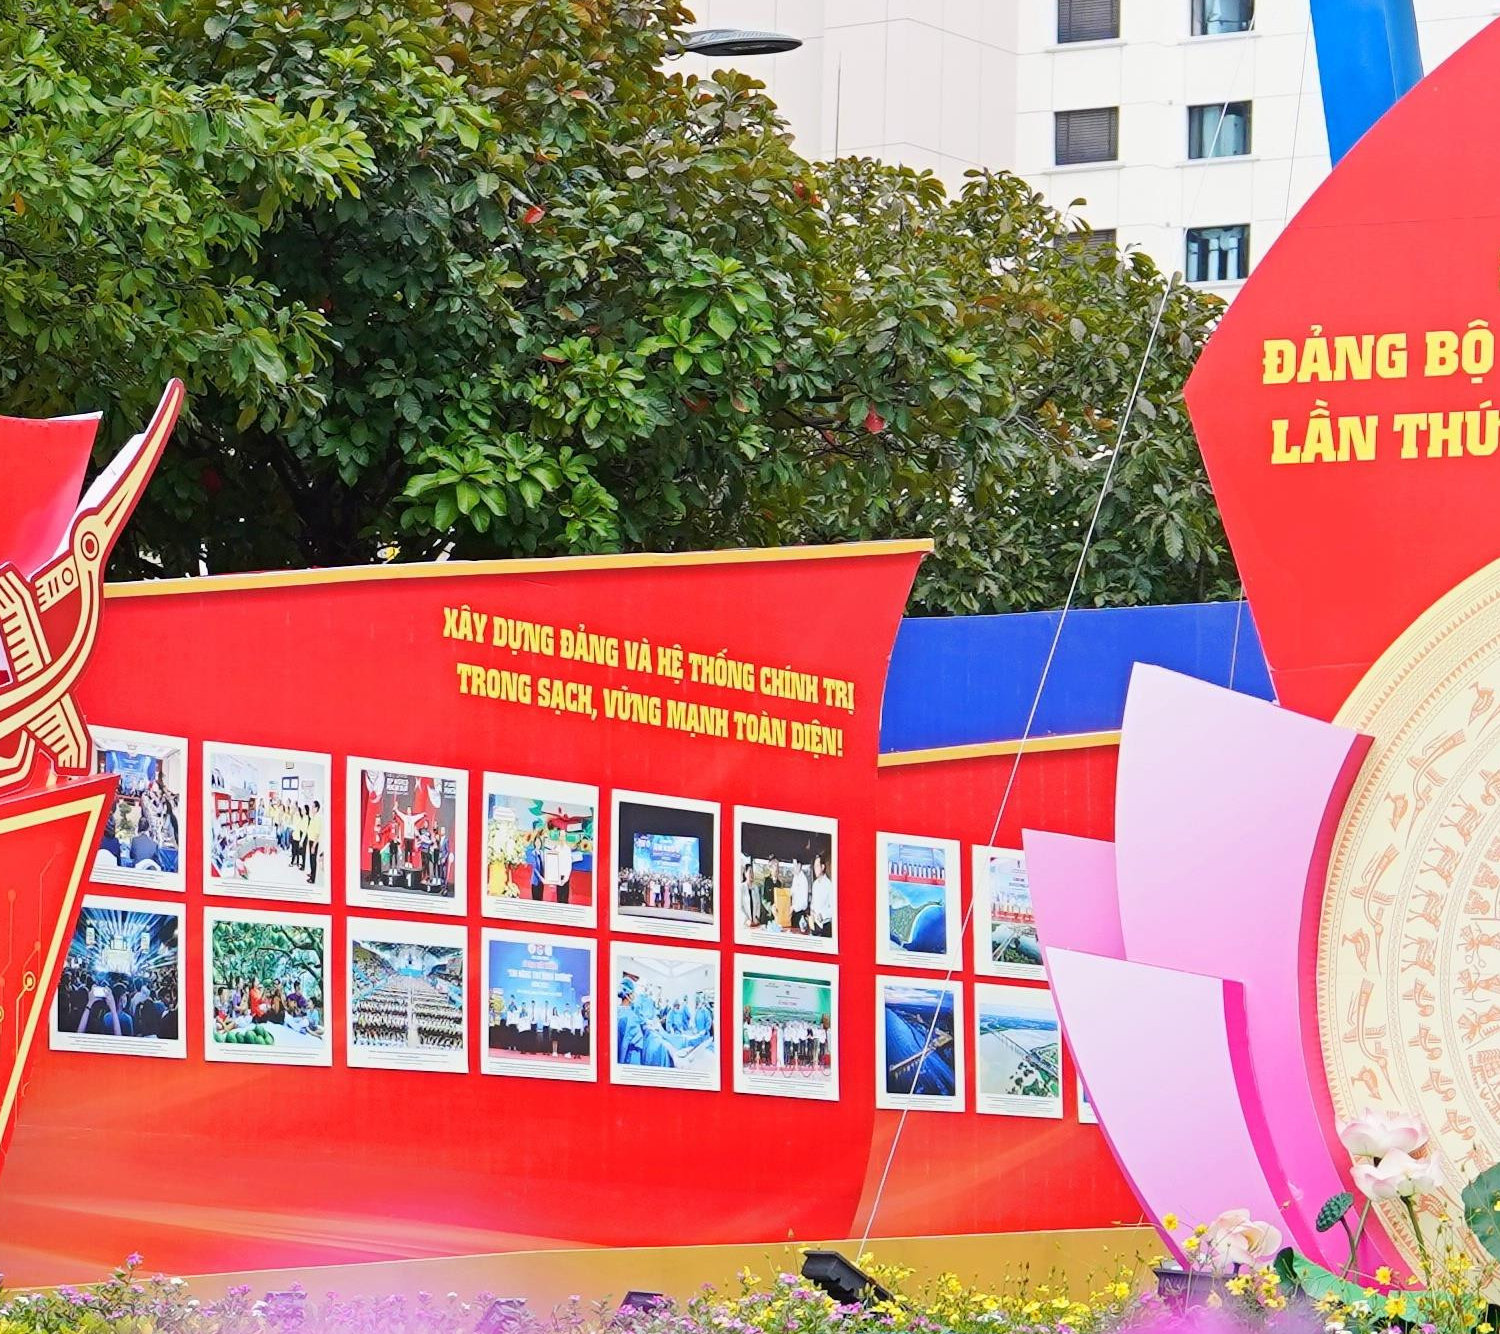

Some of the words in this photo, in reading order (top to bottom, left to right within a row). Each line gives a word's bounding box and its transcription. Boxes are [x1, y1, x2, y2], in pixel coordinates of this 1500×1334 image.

[1262, 323, 1408, 385] ĐẢNG
[1423, 317, 1495, 384] BỘ
[1270, 398, 1379, 465] LẦN
[442, 603, 488, 644] XÂY
[492, 615, 555, 656] DỰNG
[559, 623, 619, 668] ĐẢNG
[624, 636, 653, 674] VÀ
[657, 643, 684, 685] HỆ
[688, 647, 755, 693] THỐNG
[759, 664, 819, 704] CHÍNH
[822, 676, 855, 715] TRỊ
[456, 661, 532, 705] TRONG
[537, 676, 598, 721] SẠCH,
[602, 684, 662, 727] VỮNG
[666, 698, 729, 738] MẠNH
[733, 709, 787, 748] TOÀN
[791, 718, 843, 759] DIỆN!
